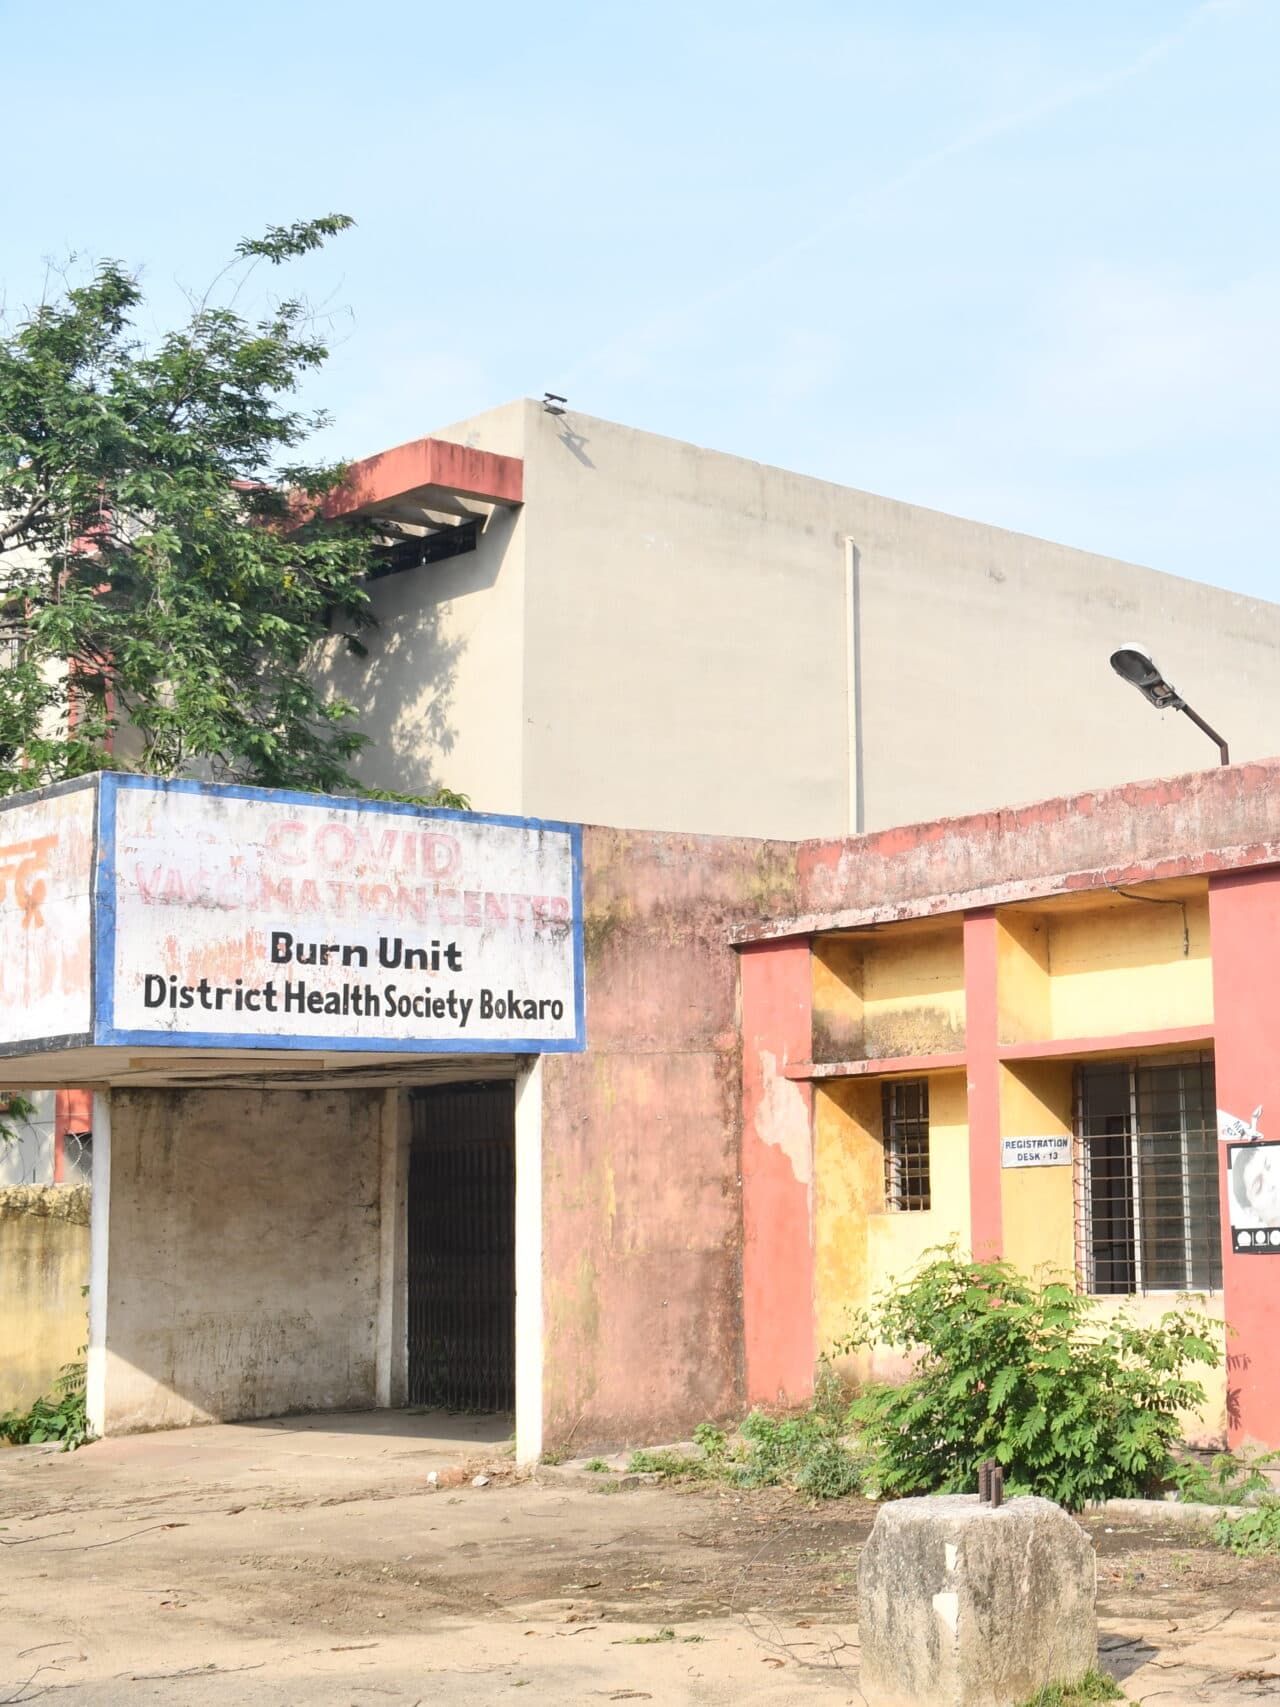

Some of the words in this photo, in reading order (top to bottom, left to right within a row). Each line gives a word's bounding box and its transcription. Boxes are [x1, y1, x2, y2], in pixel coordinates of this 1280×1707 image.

[265, 820, 462, 879] COVID
[270, 931, 368, 967] Burn
[378, 937, 463, 972] Unit
[143, 974, 278, 1012] District
[284, 981, 379, 1016] Health
[385, 985, 473, 1028] Society
[480, 989, 564, 1020] Bokaro
[1005, 1138, 1068, 1149] REGISTRATION
[1017, 1153, 1041, 1161] DESK
[1048, 1152, 1058, 1160] 13
